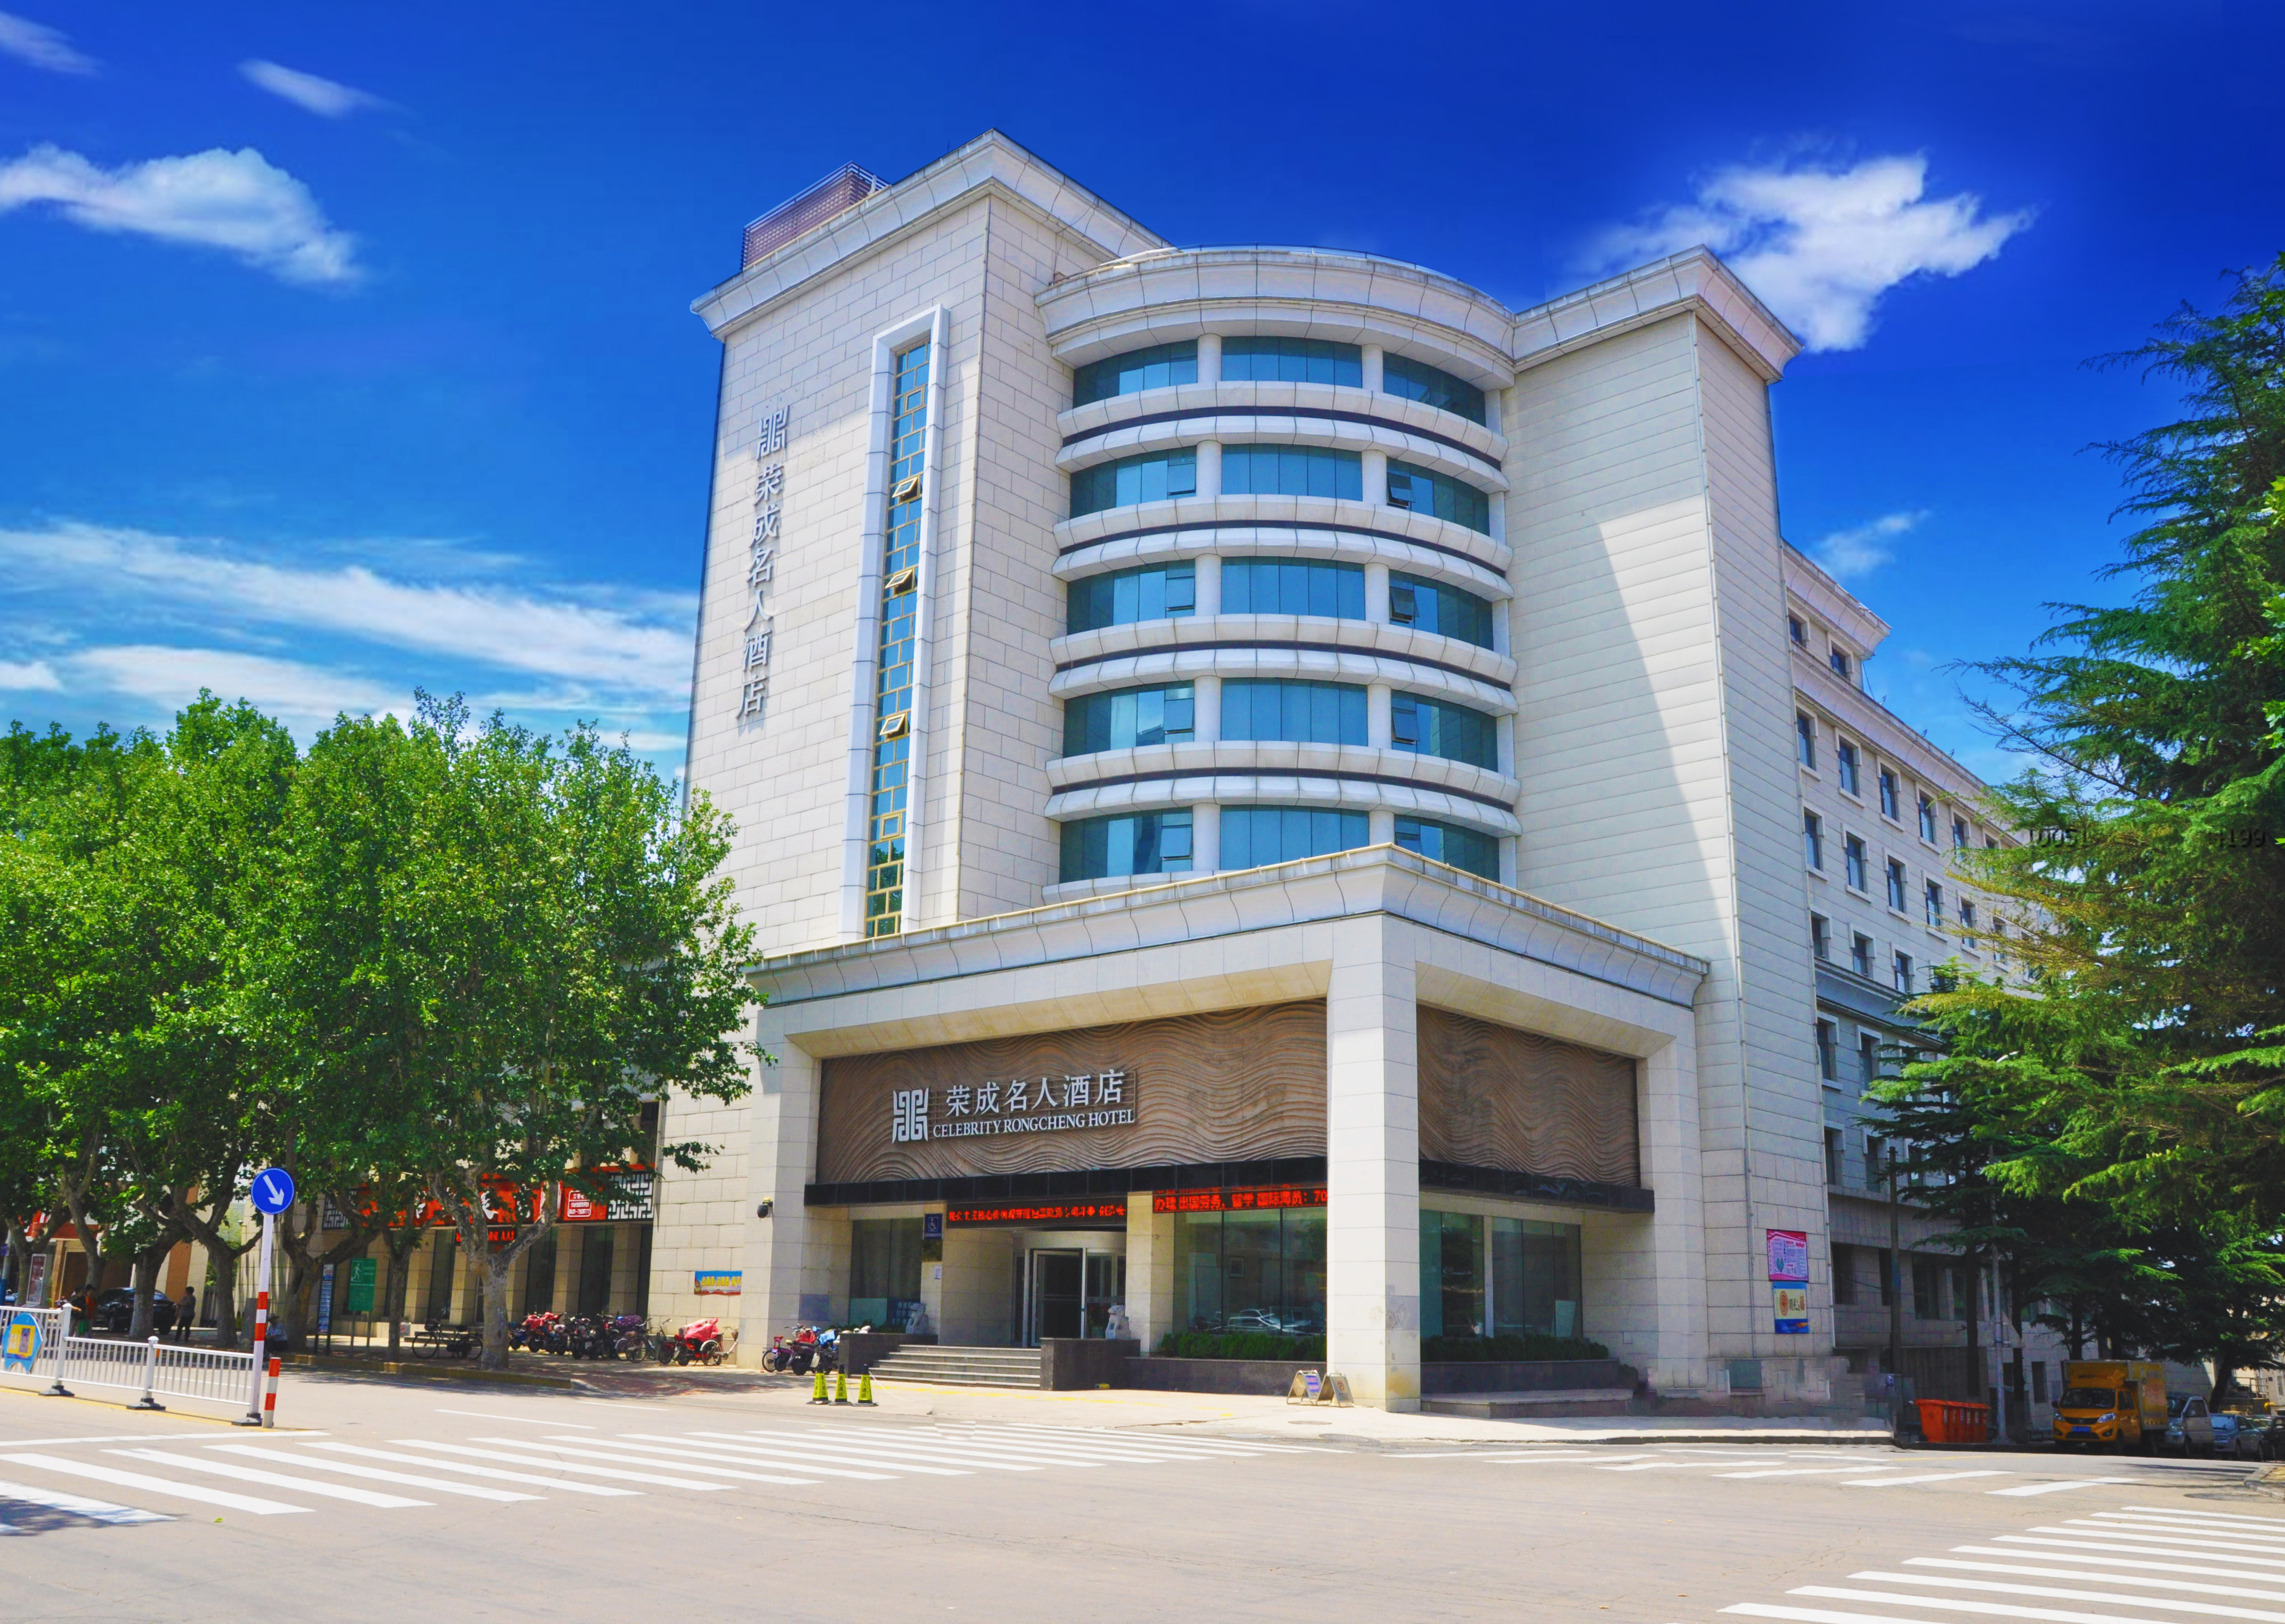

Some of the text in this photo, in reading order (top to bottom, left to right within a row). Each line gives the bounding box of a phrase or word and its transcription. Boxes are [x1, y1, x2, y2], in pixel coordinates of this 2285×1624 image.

[736, 461, 784, 720] 荣成名人酒店
[945, 1069, 1125, 1117] 荣成名人酒店
[933, 1109, 1136, 1138] CELEBRITY RONGCHENG HOTEL
